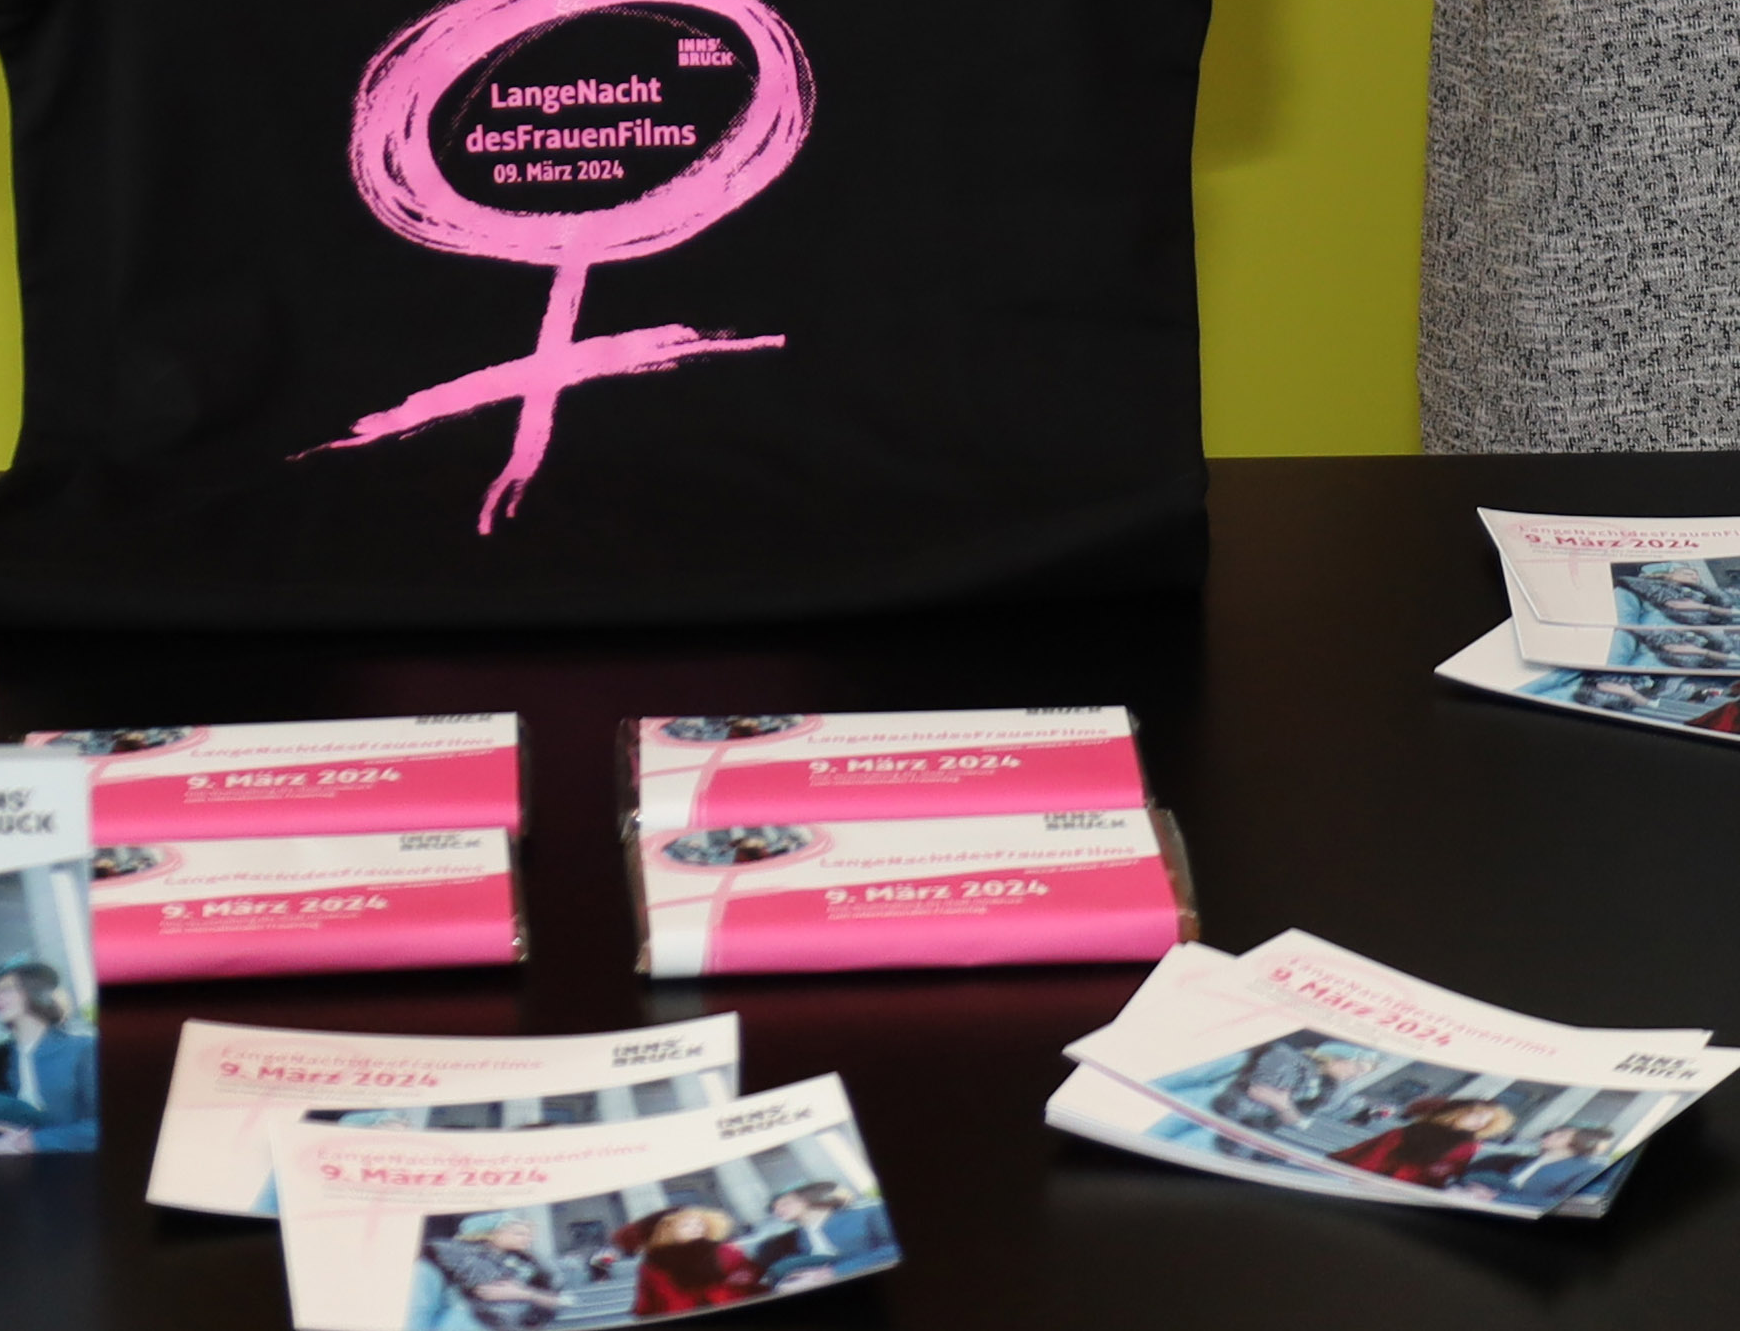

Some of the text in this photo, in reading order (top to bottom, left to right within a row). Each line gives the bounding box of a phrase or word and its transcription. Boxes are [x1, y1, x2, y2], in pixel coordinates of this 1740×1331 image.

[678, 51, 735, 67] BRUCK
[490, 75, 662, 114] LangeNacht
[465, 119, 698, 153] desFrauenFilms
[493, 160, 625, 184] 09. März 2024
[1555, 534, 1622, 548] März
[1631, 537, 1700, 549] 2024
[846, 756, 927, 773] März
[938, 753, 1023, 771] 2024
[223, 769, 309, 789] März
[317, 766, 402, 784] 2024
[865, 883, 952, 903] März
[961, 878, 1050, 898] 2024
[1297, 979, 1370, 1018] März
[1378, 1007, 1453, 1048] 2024
